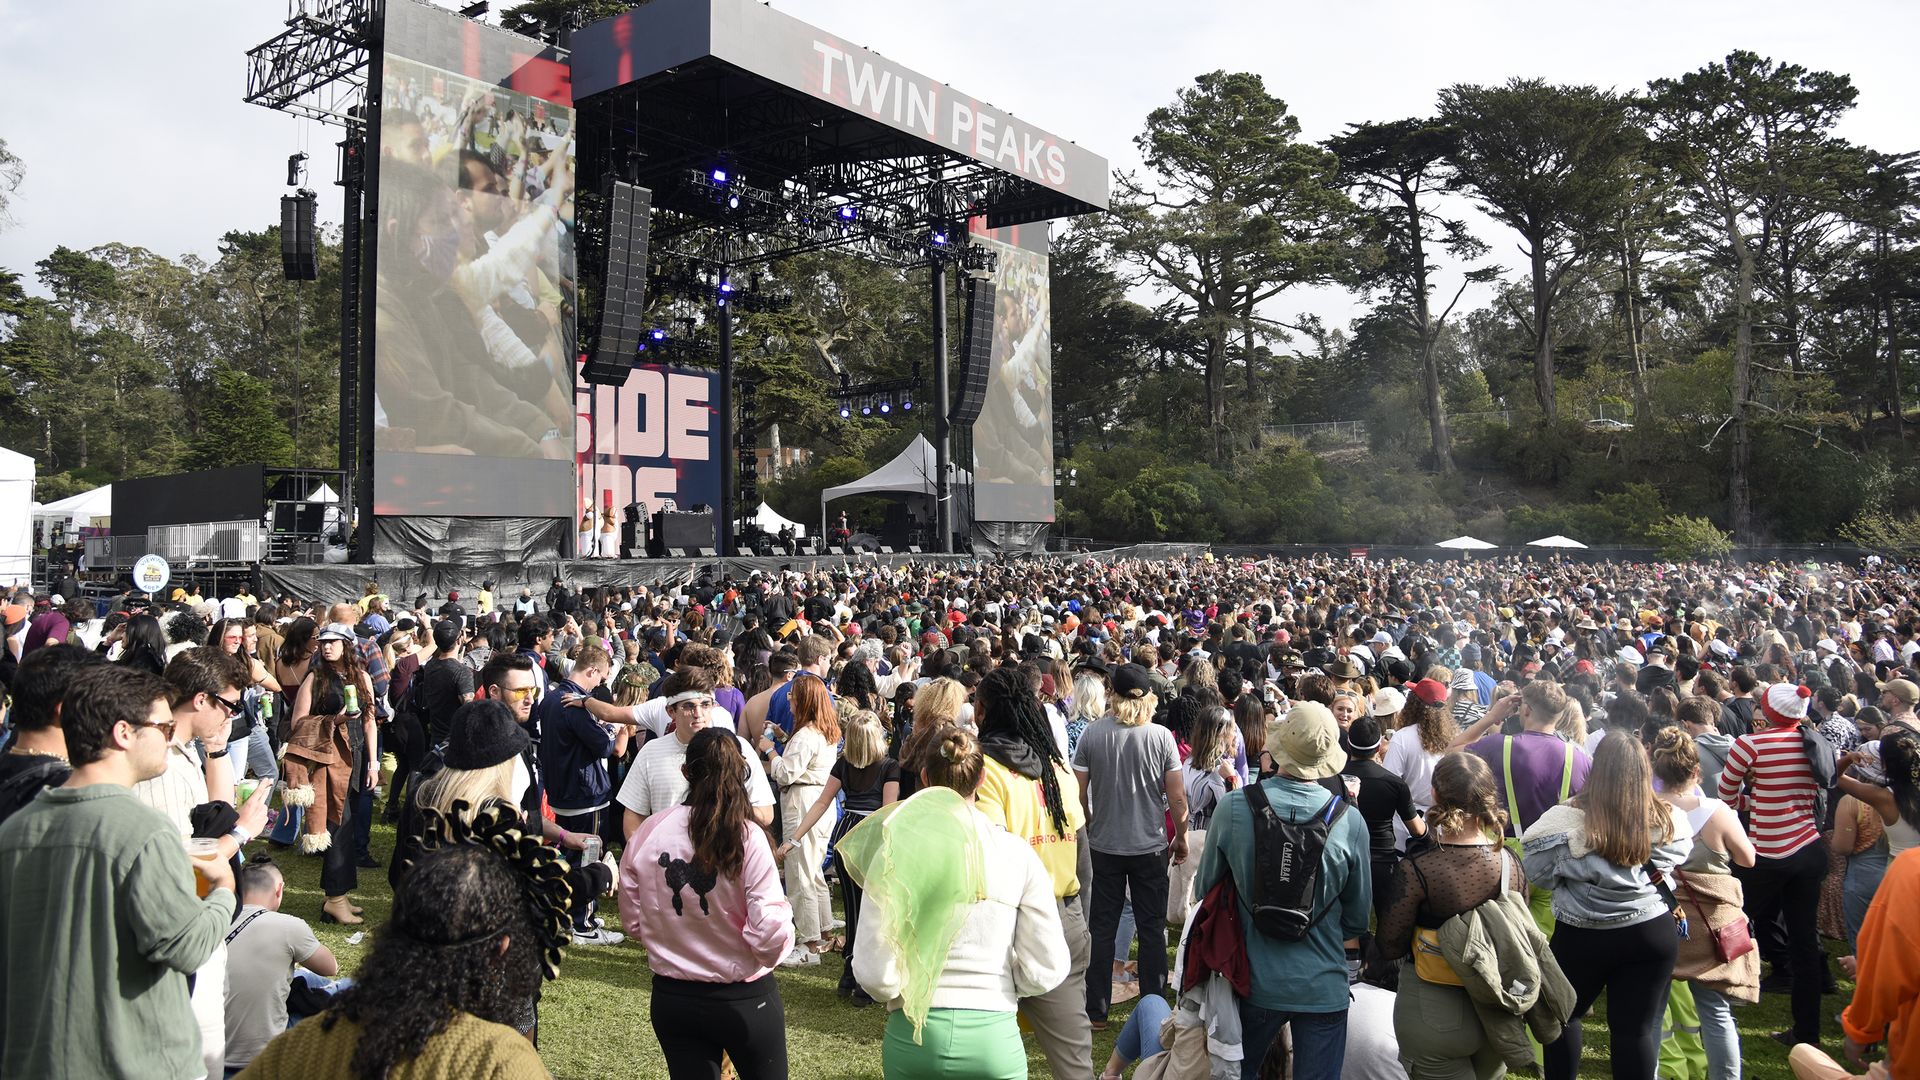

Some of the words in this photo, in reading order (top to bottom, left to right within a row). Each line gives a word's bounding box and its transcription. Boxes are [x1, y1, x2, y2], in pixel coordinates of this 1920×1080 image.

[813, 40, 936, 135] TWIN
[951, 101, 1066, 185] PEAKS
[1280, 842, 1293, 882] CAMELBAK
